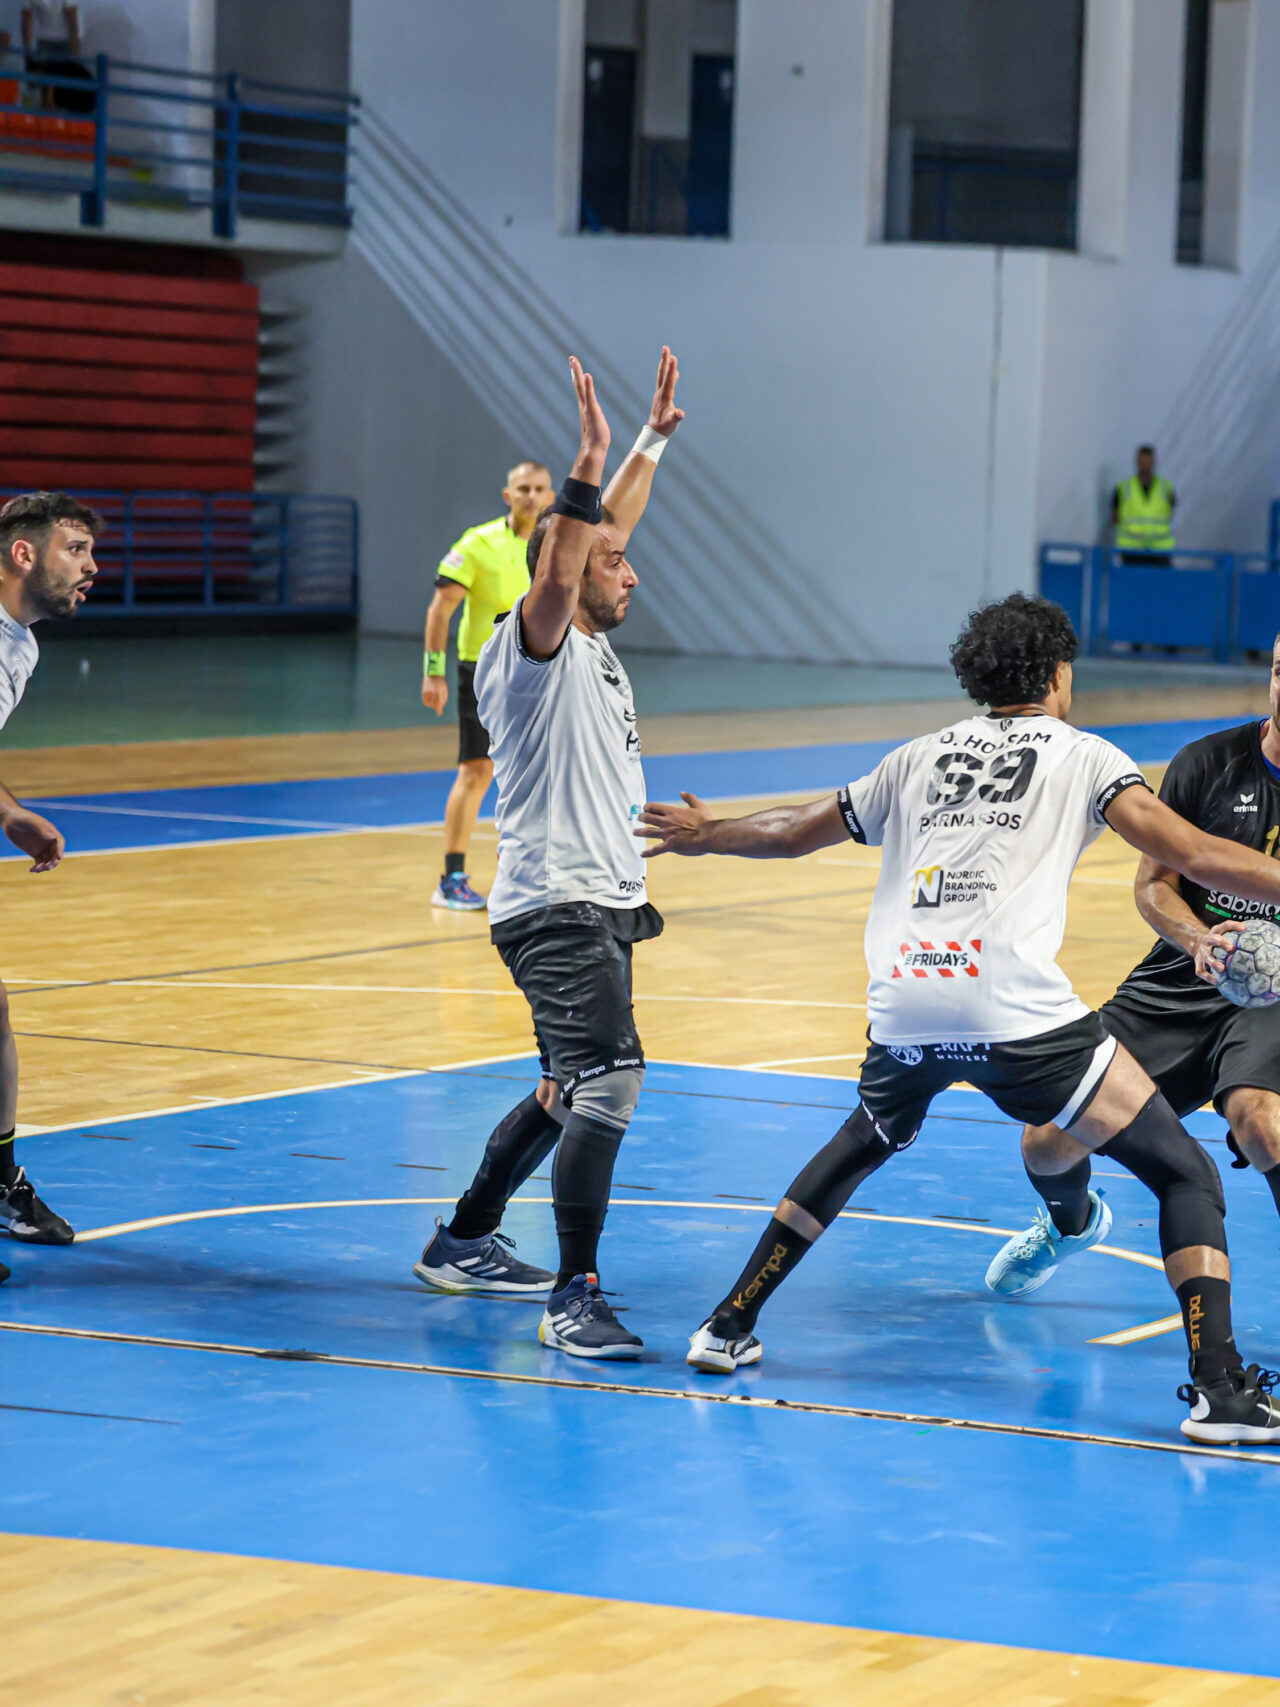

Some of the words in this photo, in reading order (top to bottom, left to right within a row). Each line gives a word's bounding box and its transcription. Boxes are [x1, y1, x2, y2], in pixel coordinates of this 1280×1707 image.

[927, 747, 1038, 806] 69
[1233, 804, 1259, 813] erima
[946, 870, 985, 880] NORDIC
[944, 882, 998, 892] BRANDING
[943, 893, 978, 903] GROUP
[911, 952, 968, 966] FRIDAYS
[613, 1057, 641, 1068] Kempa
[936, 1054, 989, 1062] MASTERS
[578, 1064, 606, 1079] Kempa
[732, 1243, 789, 1311] Kempa
[1189, 1294, 1206, 1351] empa
